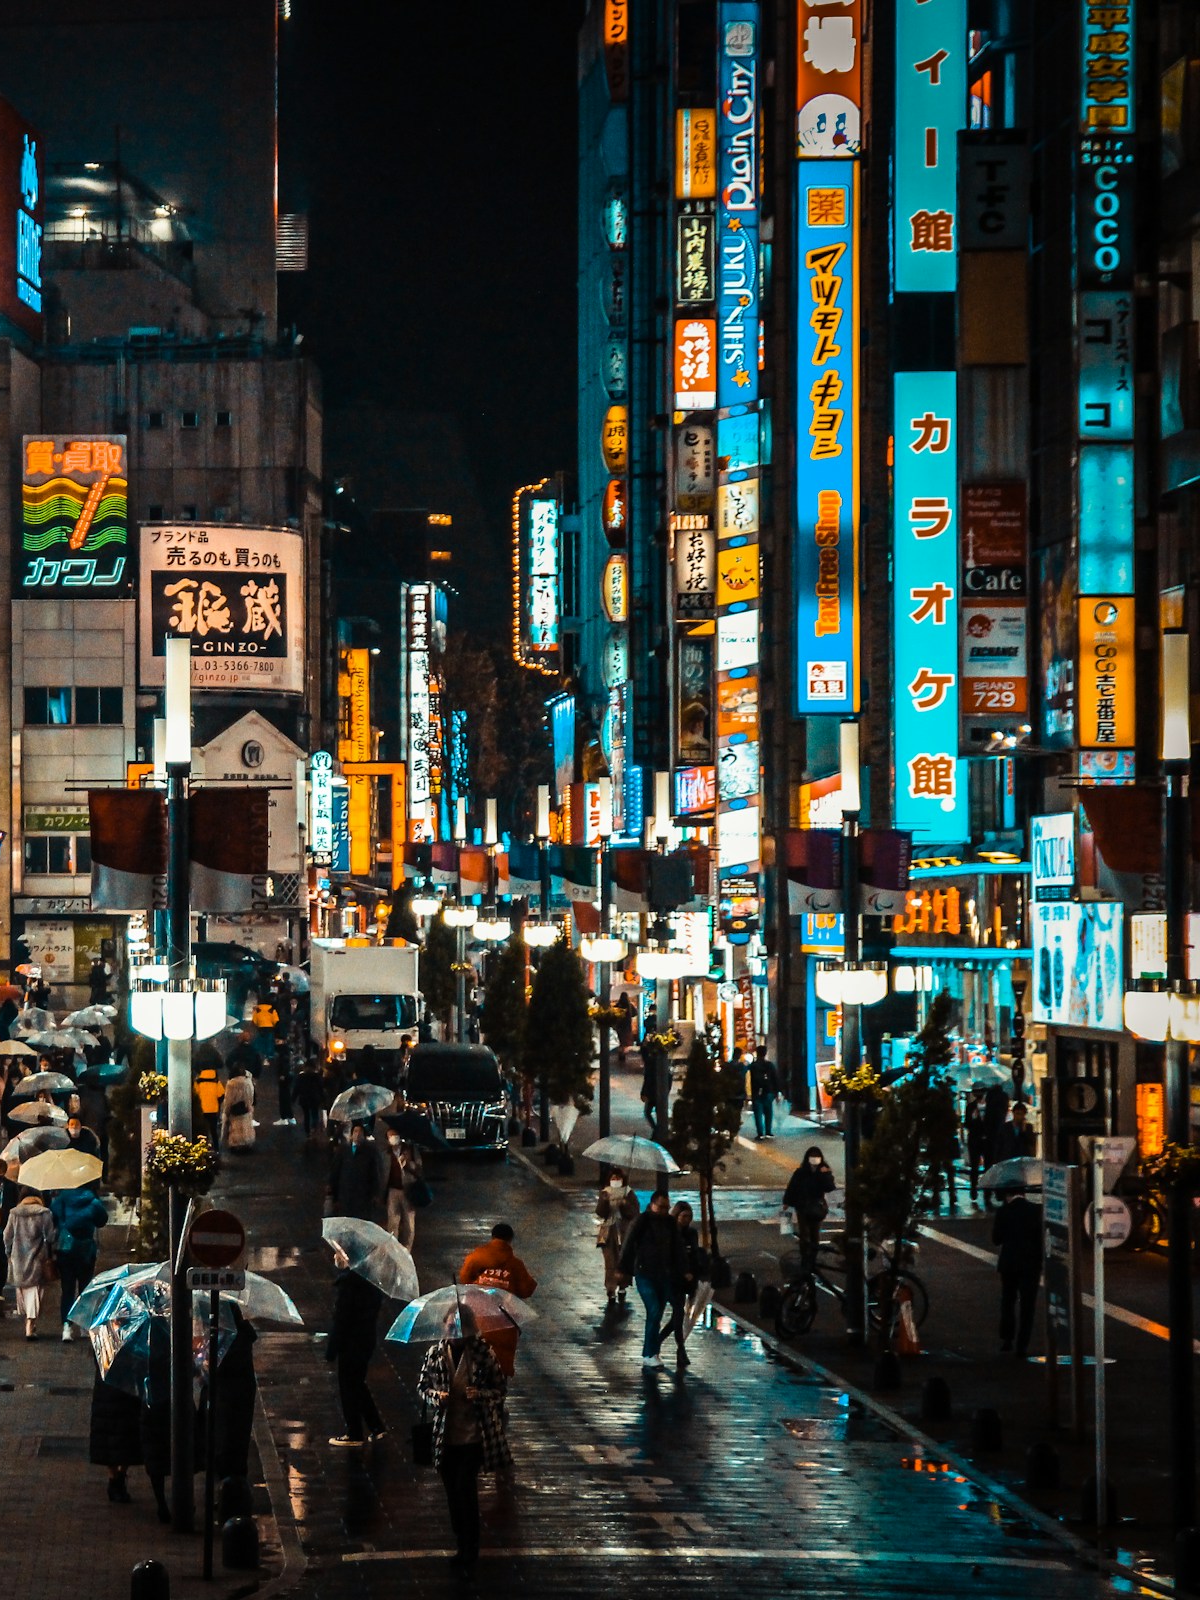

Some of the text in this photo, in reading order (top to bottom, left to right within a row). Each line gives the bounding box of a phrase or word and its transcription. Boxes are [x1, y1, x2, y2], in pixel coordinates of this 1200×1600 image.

[1094, 165, 1120, 272] COCO
[684, 218, 708, 289] 山内農場
[805, 243, 848, 460] マツモトキヨシ
[151, 531, 209, 544] ブランド品
[24, 556, 128, 588] カワノ
[166, 546, 281, 569] 売るのも 買うのも
[815, 490, 842, 637] Shop Free Tax
[965, 568, 1023, 592] Cafe
[908, 412, 957, 799] カラオケ館
[973, 682, 1016, 691] BRAND
[973, 691, 1017, 708] 729
